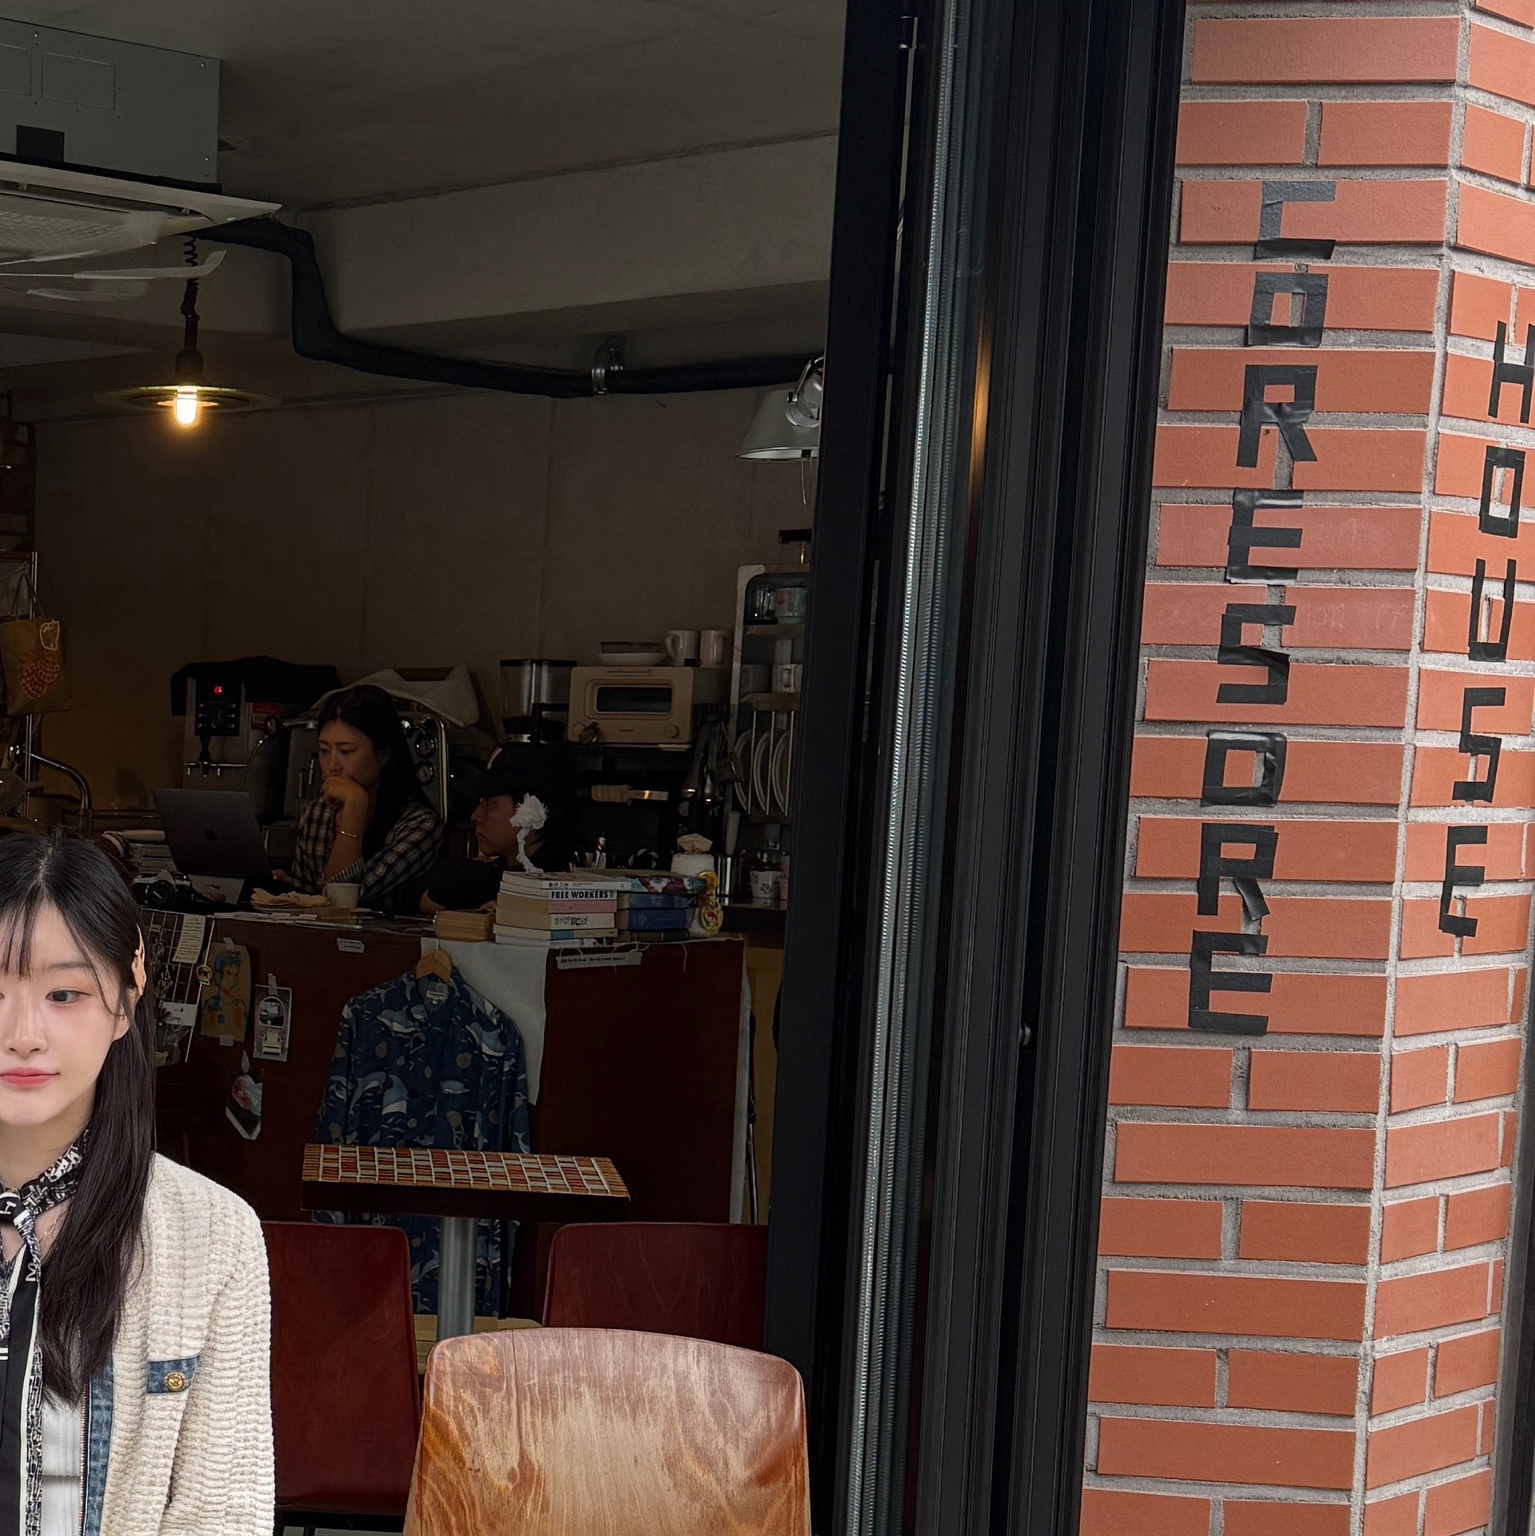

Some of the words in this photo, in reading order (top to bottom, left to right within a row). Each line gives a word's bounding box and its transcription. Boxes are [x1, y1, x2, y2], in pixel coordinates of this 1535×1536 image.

[1439, 319, 1535, 938] HOUSE
[551, 890, 569, 899] FREE
[571, 889, 609, 899] WORKERS
